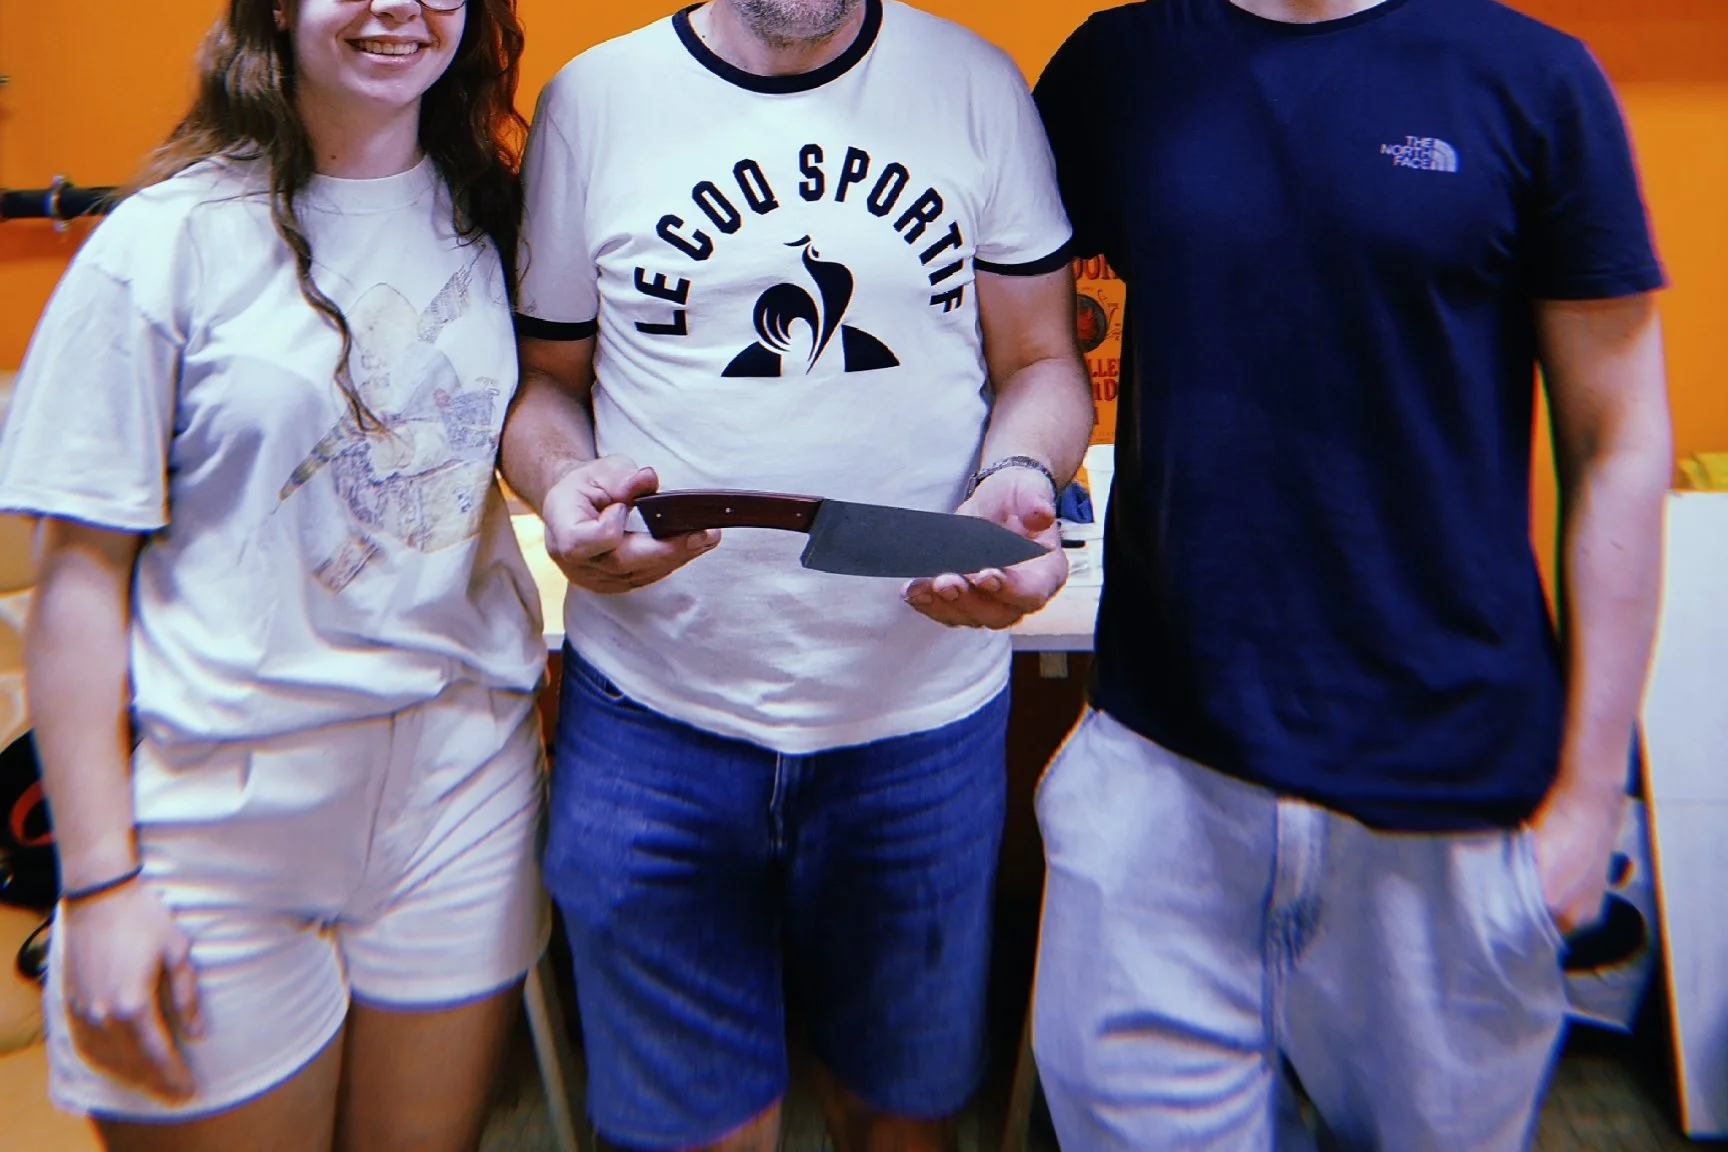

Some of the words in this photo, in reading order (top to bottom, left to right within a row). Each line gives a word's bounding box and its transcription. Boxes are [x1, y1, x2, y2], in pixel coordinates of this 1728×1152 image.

[1379, 143, 1432, 160] NORTH
[1392, 154, 1431, 170] FACE
[1404, 135, 1433, 148] THE
[655, 158, 780, 262] COQ
[798, 142, 966, 314] SPORTIF
[633, 266, 691, 336] LE
